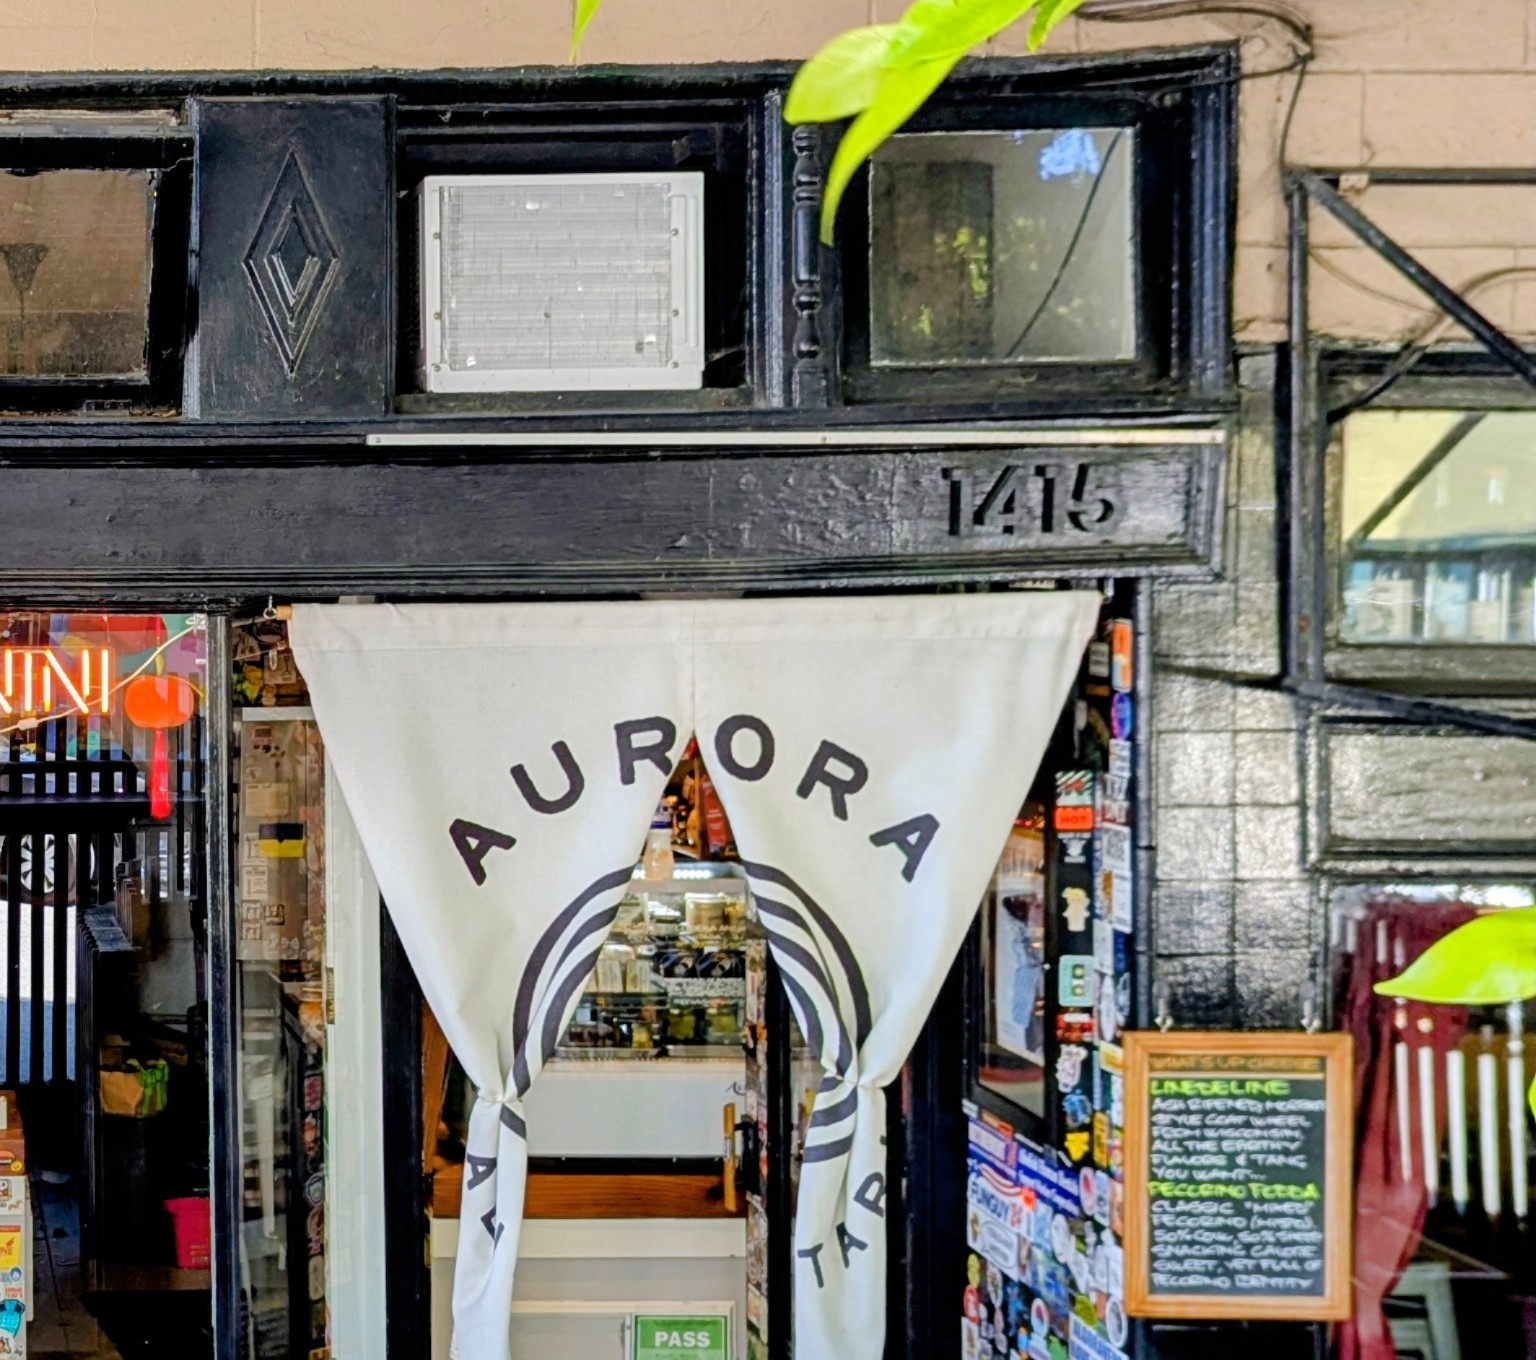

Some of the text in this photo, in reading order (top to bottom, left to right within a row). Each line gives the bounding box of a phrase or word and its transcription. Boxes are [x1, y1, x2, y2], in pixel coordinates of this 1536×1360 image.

[941, 463, 1114, 536] 1415
[449, 714, 940, 886] AURORA
[1151, 1139, 1184, 1153] ALL
[1183, 1140, 1220, 1152] THE
[1152, 1167, 1190, 1180] YOU
[1151, 1200, 1236, 1215] CLASSIC
[1151, 1214, 1249, 1229] PECORINO
[1225, 1258, 1260, 1271] YET
[1303, 1258, 1324, 1272] OF
[655, 1330, 711, 1348] PASS
